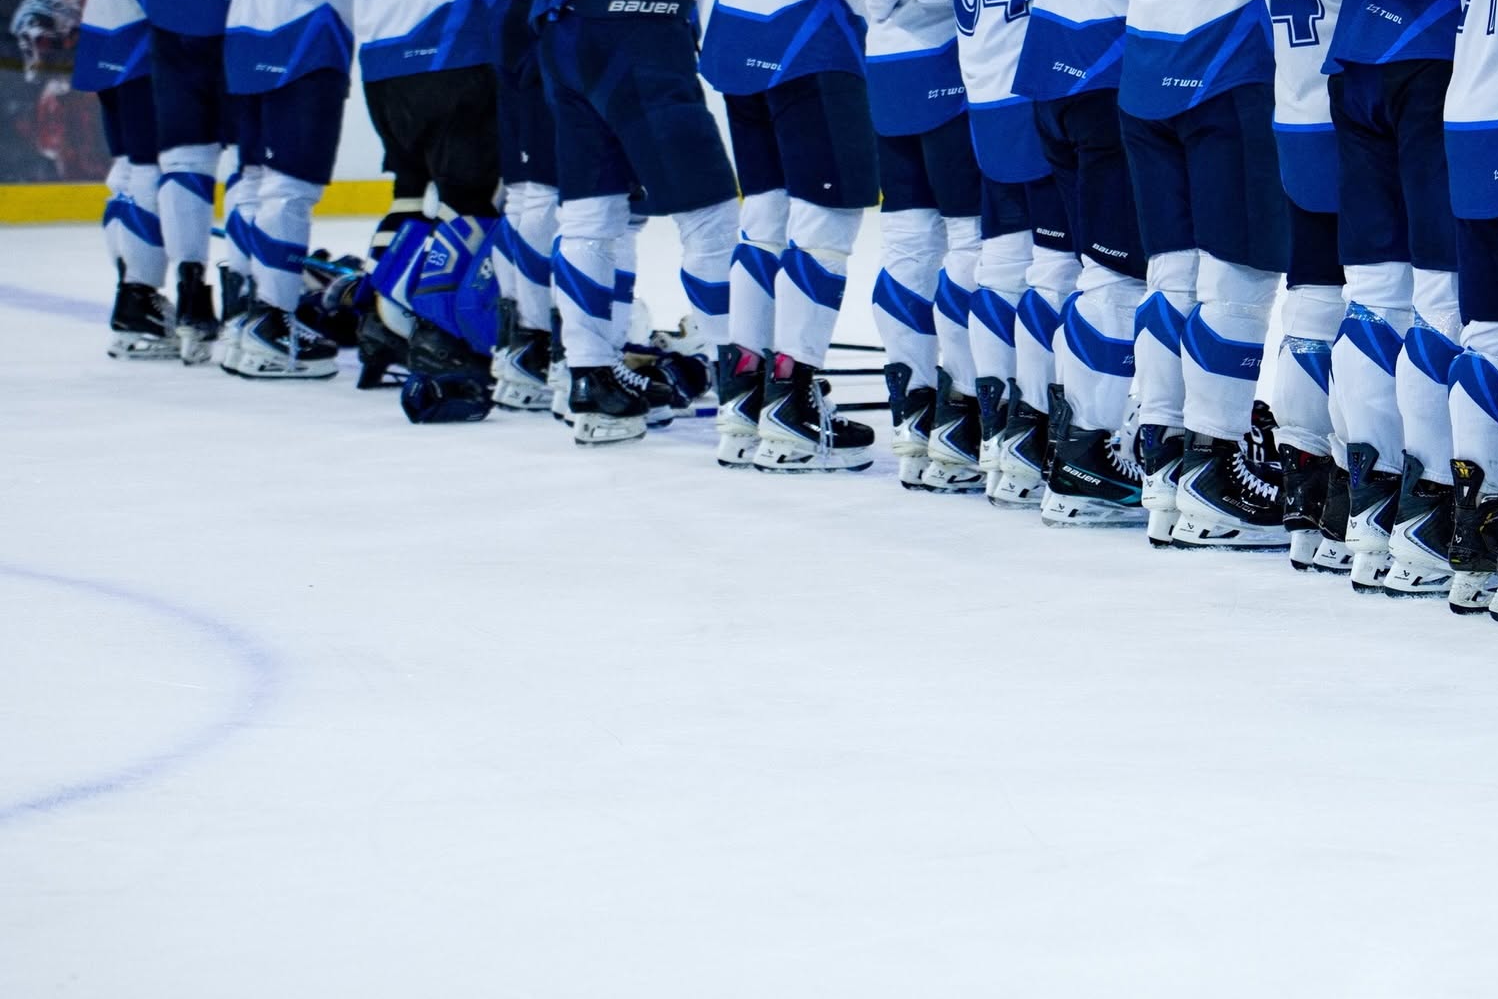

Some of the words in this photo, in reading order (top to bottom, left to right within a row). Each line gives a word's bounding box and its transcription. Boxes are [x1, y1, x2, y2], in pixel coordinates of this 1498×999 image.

[608, 0, 680, 15] BAUER
[1380, 10, 1403, 25] TWOL
[939, 86, 965, 97] TWO
[1036, 227, 1066, 239] BAUER
[1091, 242, 1129, 258] BAUER
[1062, 465, 1102, 486] BAUER
